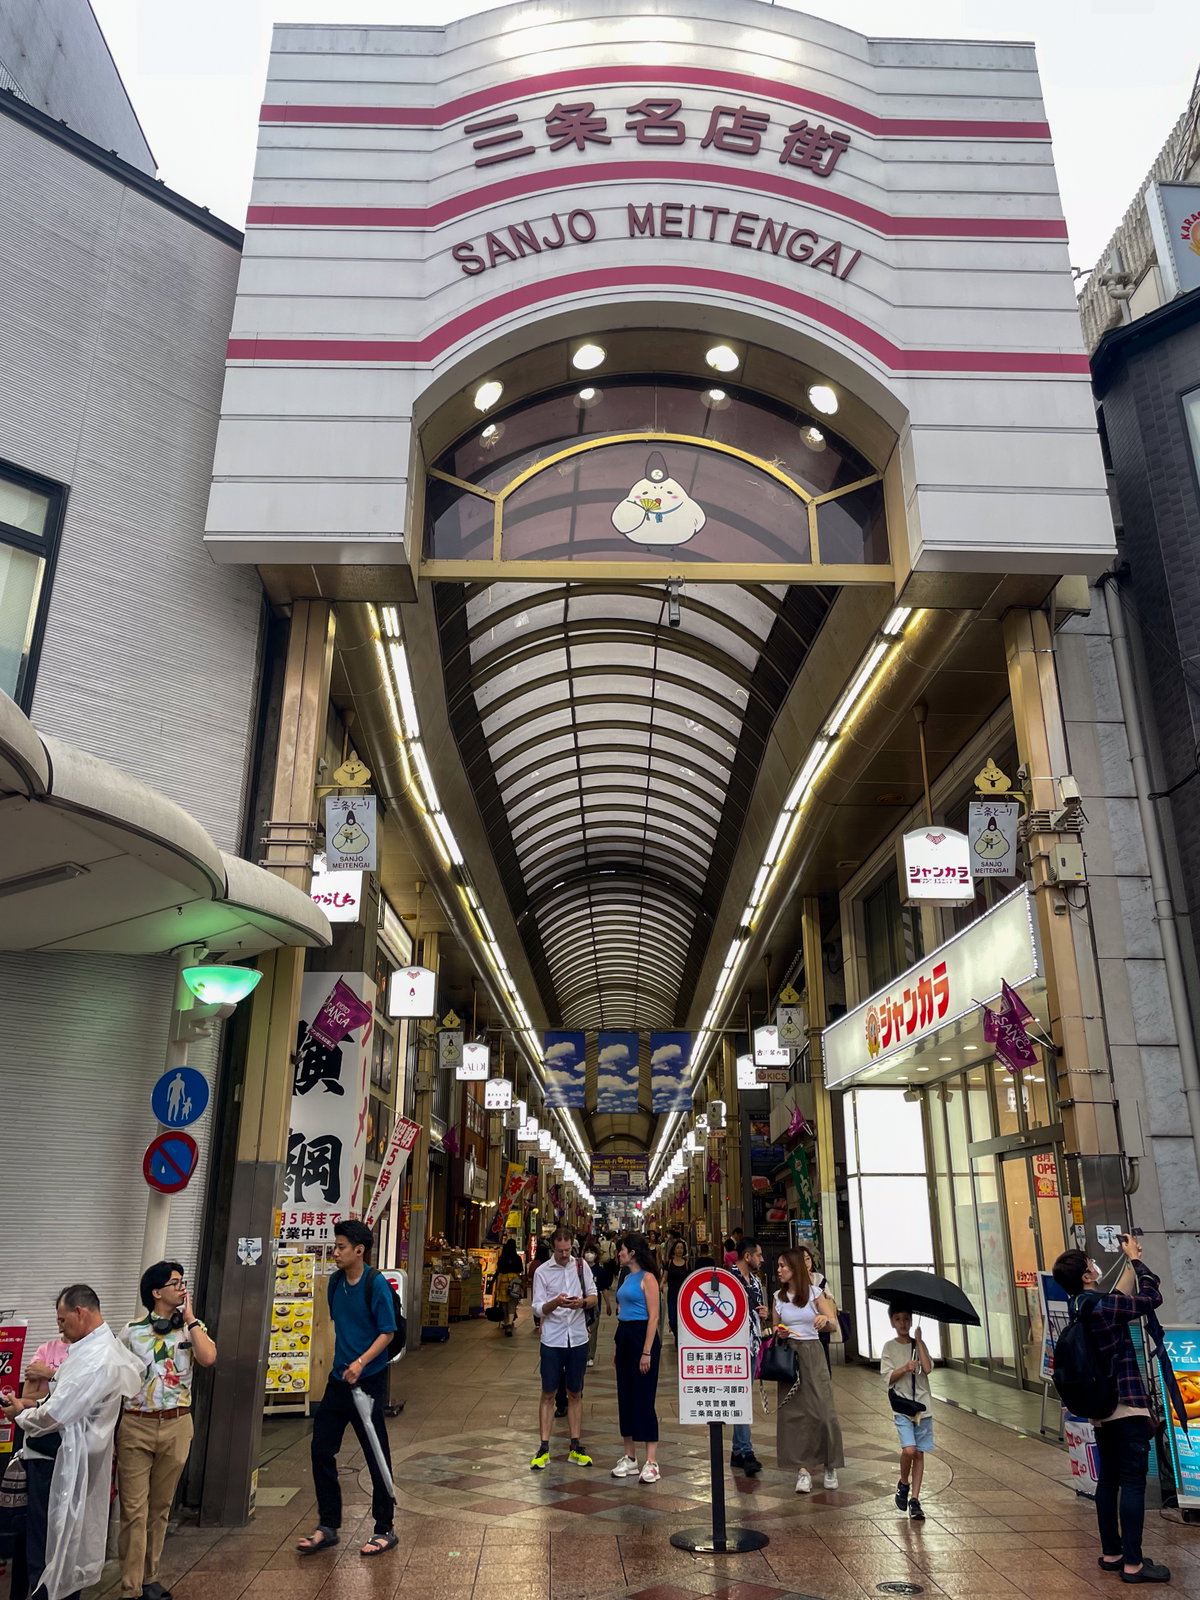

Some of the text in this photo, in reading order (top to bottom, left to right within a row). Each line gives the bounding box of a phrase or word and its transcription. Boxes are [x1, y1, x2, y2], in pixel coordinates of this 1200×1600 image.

[464, 98, 851, 177] 三条名店街
[452, 202, 862, 280] SANJO MEITENGAI
[909, 865, 969, 878] ジャンカラ
[336, 1001, 351, 1014] KYOTO
[879, 961, 950, 1049] ジャンカラ
[324, 1003, 351, 1028] SANGA
[1000, 1016, 1031, 1059] SANGA
[767, 1072, 787, 1080] KICS
[687, 1352, 742, 1361] 自転車通行は
[687, 1365, 743, 1374] 終日通行禁止
